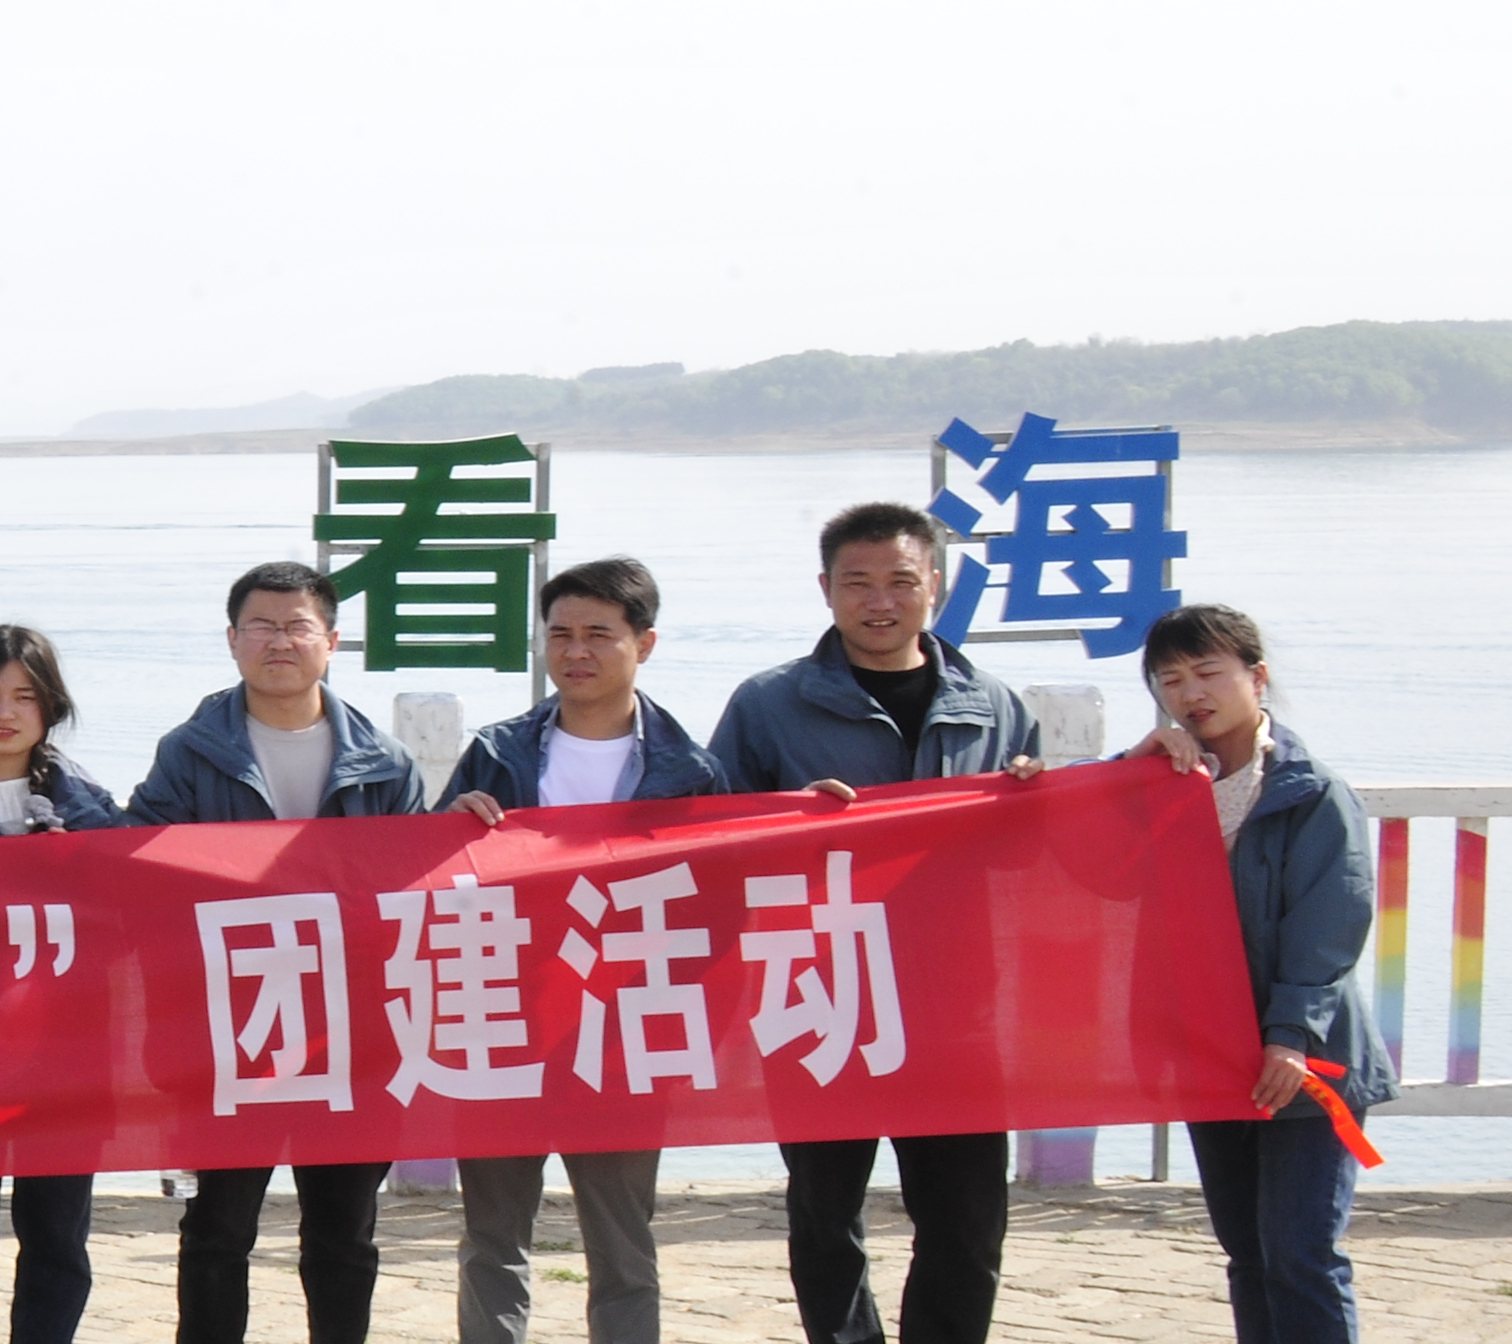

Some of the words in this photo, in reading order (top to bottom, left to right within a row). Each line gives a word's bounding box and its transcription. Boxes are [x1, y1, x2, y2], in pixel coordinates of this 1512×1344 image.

[312, 433, 557, 672] 看
[928, 411, 1188, 660] 海
[194, 850, 907, 1117] 团建活动
